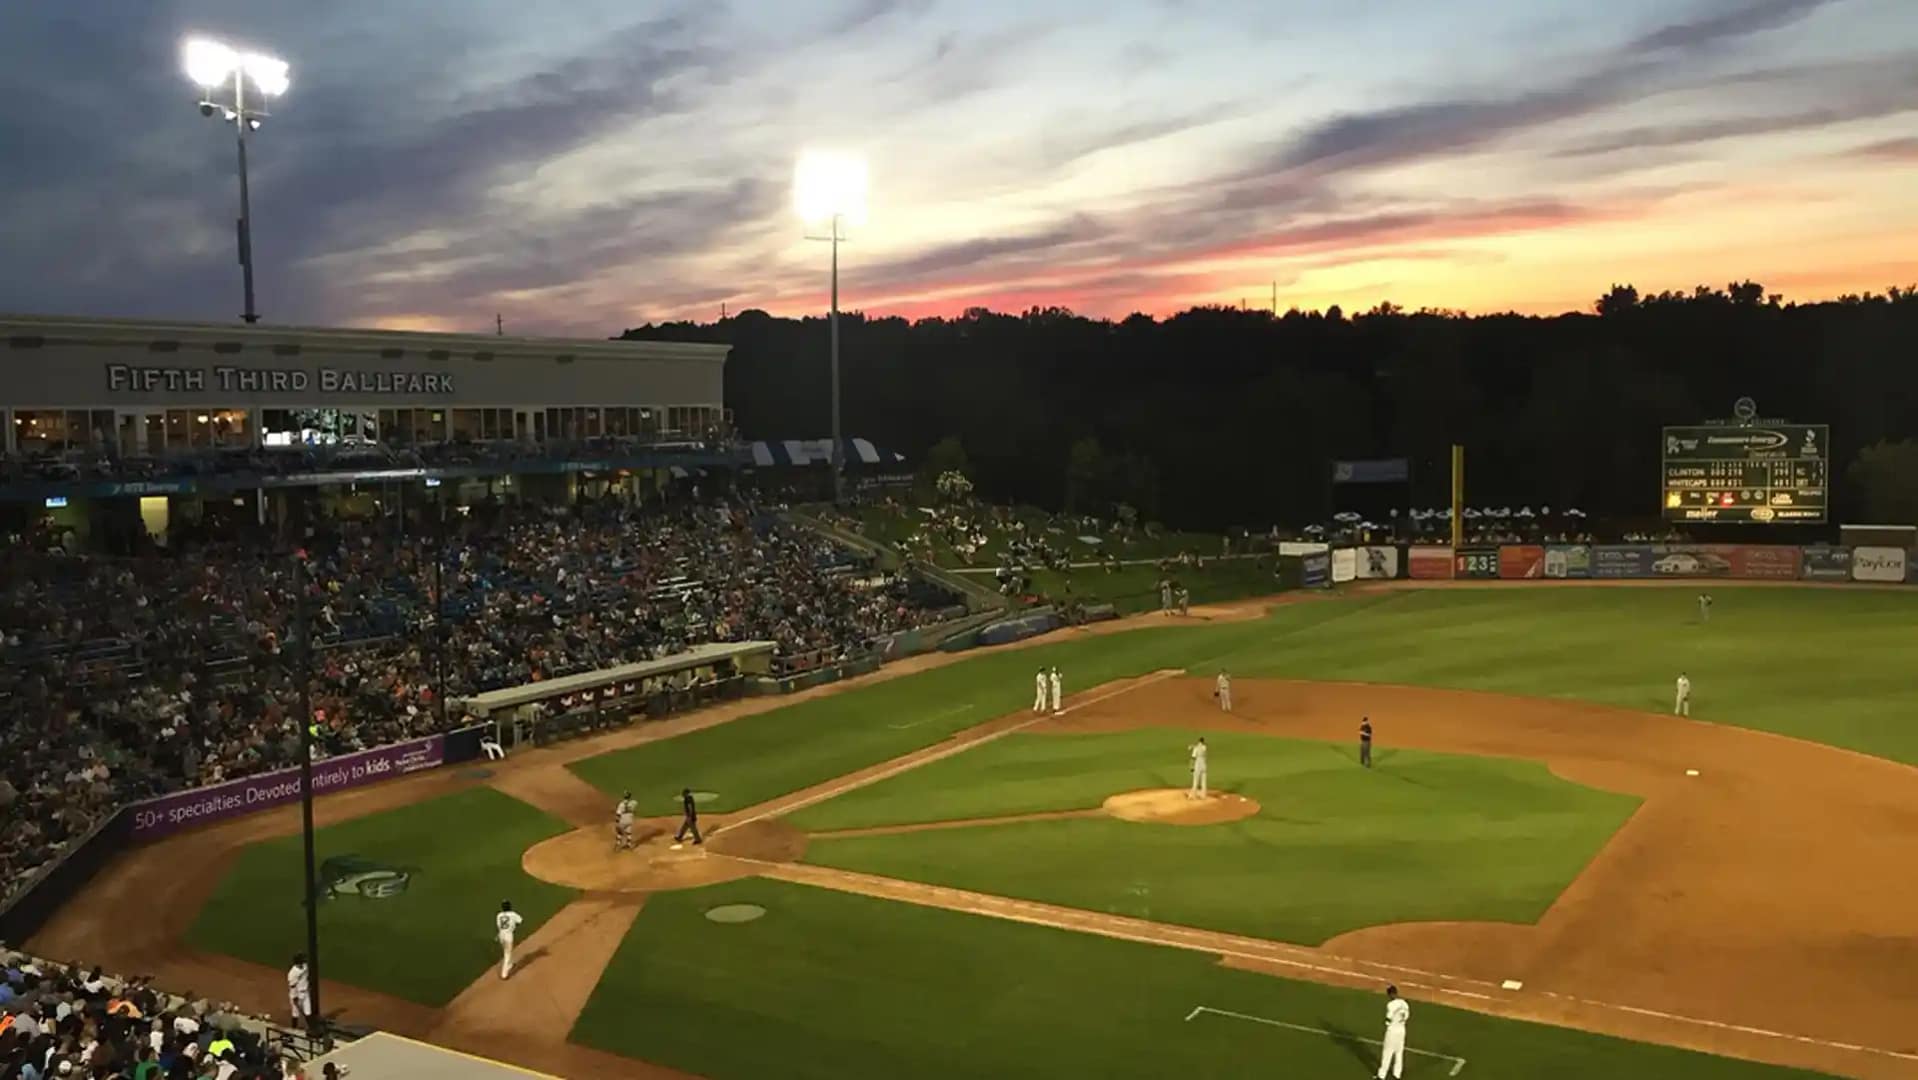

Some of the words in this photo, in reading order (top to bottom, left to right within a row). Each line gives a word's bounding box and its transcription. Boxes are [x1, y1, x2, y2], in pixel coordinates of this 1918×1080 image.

[108, 365, 204, 391] FIFTH
[216, 367, 308, 391] THIRD
[320, 369, 454, 393] BALLPARK
[1668, 468, 1705, 477] CLINTON
[1668, 479, 1708, 488] WHITECAPS
[134, 812, 165, 830] 50+
[246, 780, 301, 804] Devoted
[311, 767, 350, 790] ntirely
[352, 764, 365, 778] to
[366, 757, 391, 774] kids
